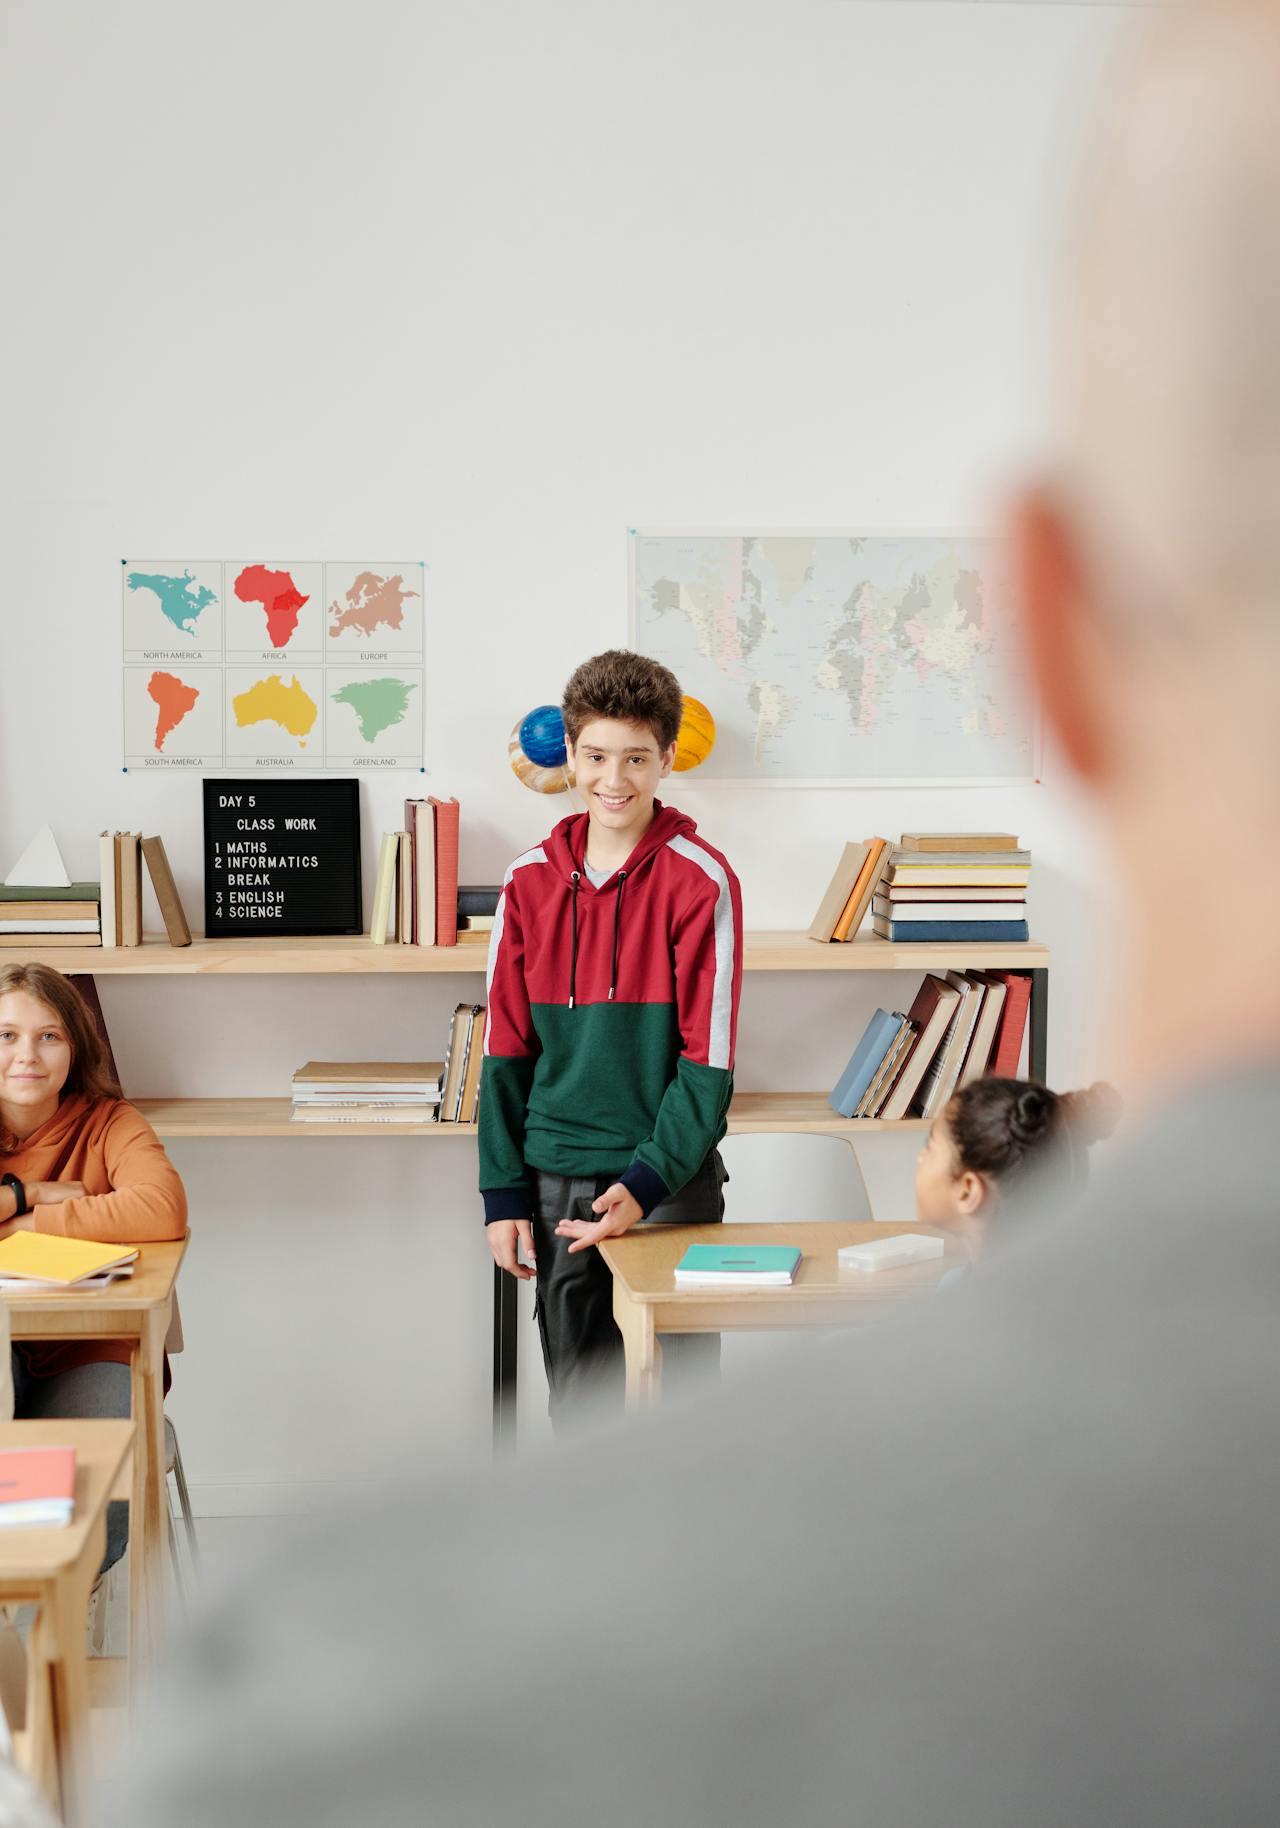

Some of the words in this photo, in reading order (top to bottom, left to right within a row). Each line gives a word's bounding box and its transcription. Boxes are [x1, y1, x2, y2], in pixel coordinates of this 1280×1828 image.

[262, 652, 287, 660] AFRICA
[144, 758, 170, 766] SOUTH
[170, 758, 203, 766] AMERICA
[255, 758, 294, 766] AUSTRALIA
[352, 758, 397, 766] GREENLAND
[219, 795, 243, 808] DAY
[248, 795, 256, 808] 5
[236, 818, 276, 831] CLASS
[284, 818, 317, 831] WORK
[215, 842, 220, 854] 1
[226, 842, 268, 854] MATHS
[214, 856, 222, 869] 2
[227, 856, 319, 868] INFORMATICS
[227, 873, 271, 885] BREAK
[215, 891, 223, 904] 3
[229, 891, 285, 904] ENGLISH
[215, 906, 223, 918] 4
[229, 905, 283, 918] SCIENCE
